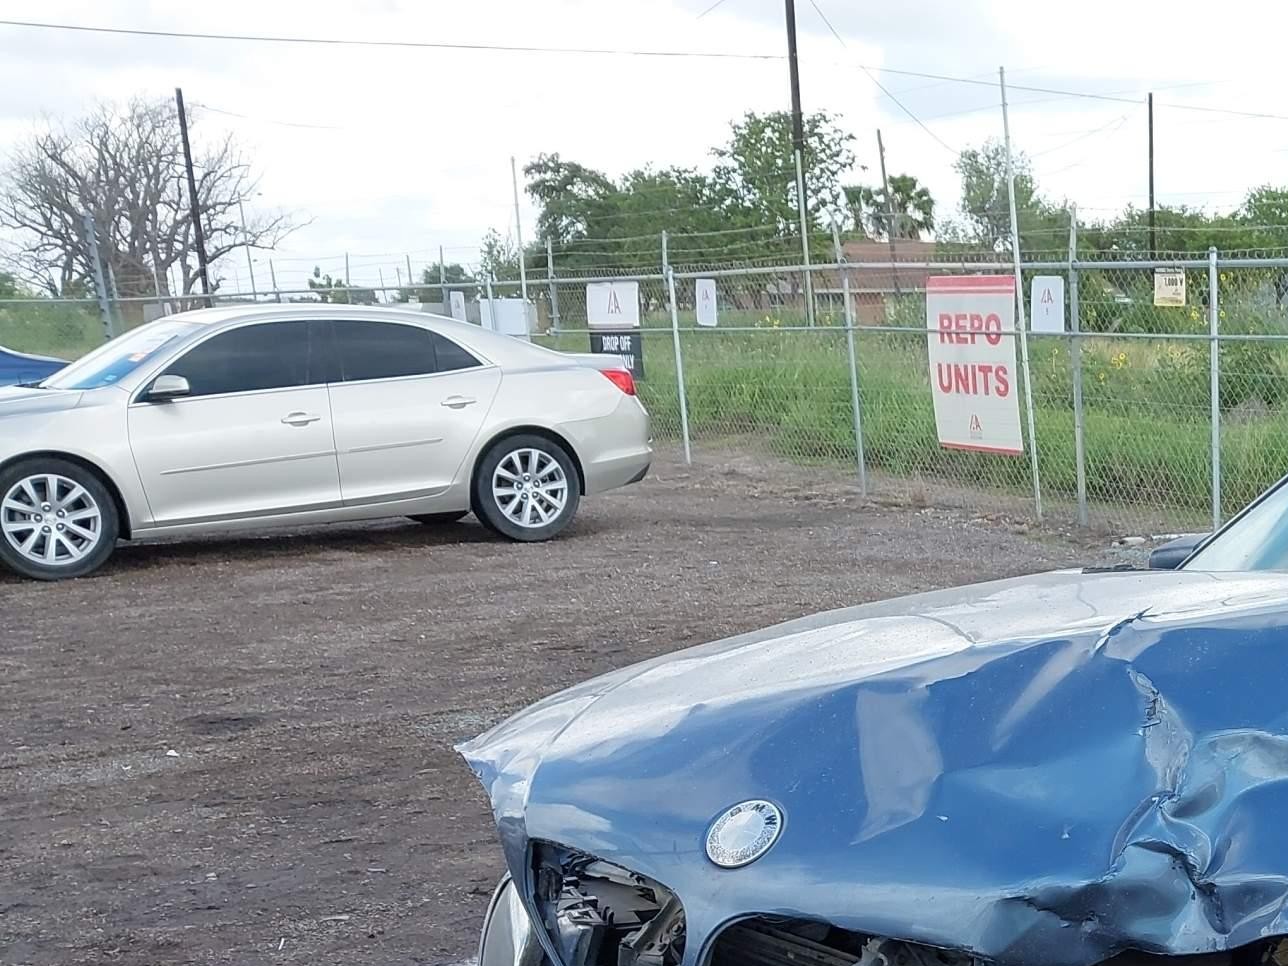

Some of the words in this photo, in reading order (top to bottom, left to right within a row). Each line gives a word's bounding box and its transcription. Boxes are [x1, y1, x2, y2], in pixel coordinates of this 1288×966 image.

[938, 313, 1002, 346] REPO
[602, 335, 619, 351] DROP
[620, 335, 632, 351] OFF
[621, 354, 634, 369] NLY
[936, 363, 1009, 397] UNITS
